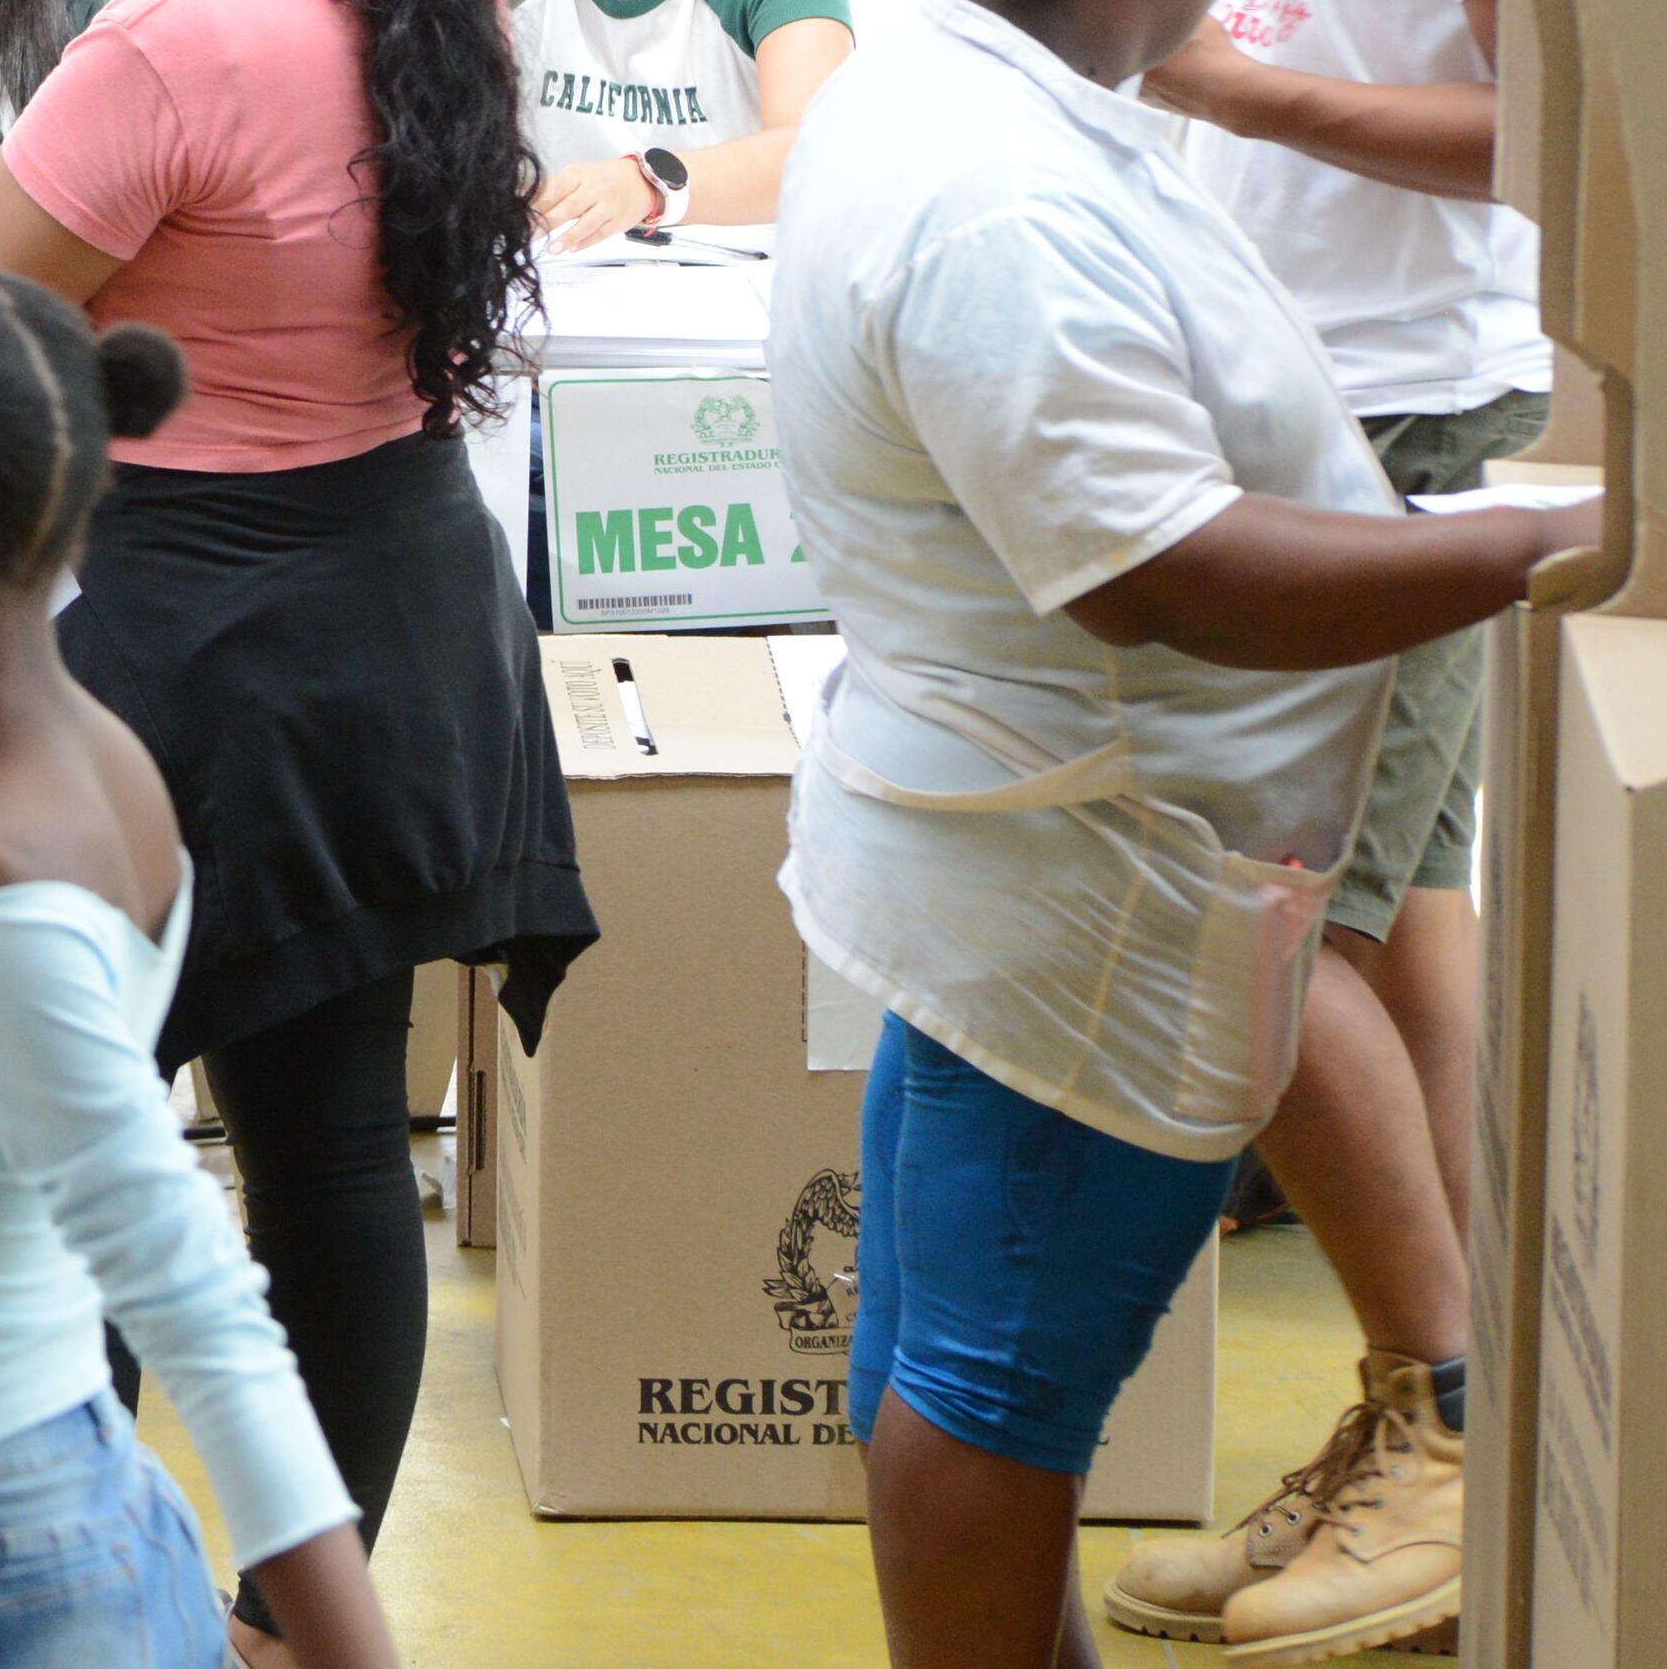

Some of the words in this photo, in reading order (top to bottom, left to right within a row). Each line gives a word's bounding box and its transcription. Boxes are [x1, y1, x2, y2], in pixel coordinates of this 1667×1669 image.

[540, 70, 707, 125] CALIFORNIA
[654, 448, 780, 466] REGISTRADUR
[654, 465, 705, 475] NACIONAL
[708, 464, 728, 472] DEL
[732, 462, 772, 471] ESTADO
[575, 503, 765, 575] MESA
[637, 1378, 849, 1415] REGIST
[637, 1422, 801, 1445] NACIONAL
[812, 1423, 856, 1445] DE
